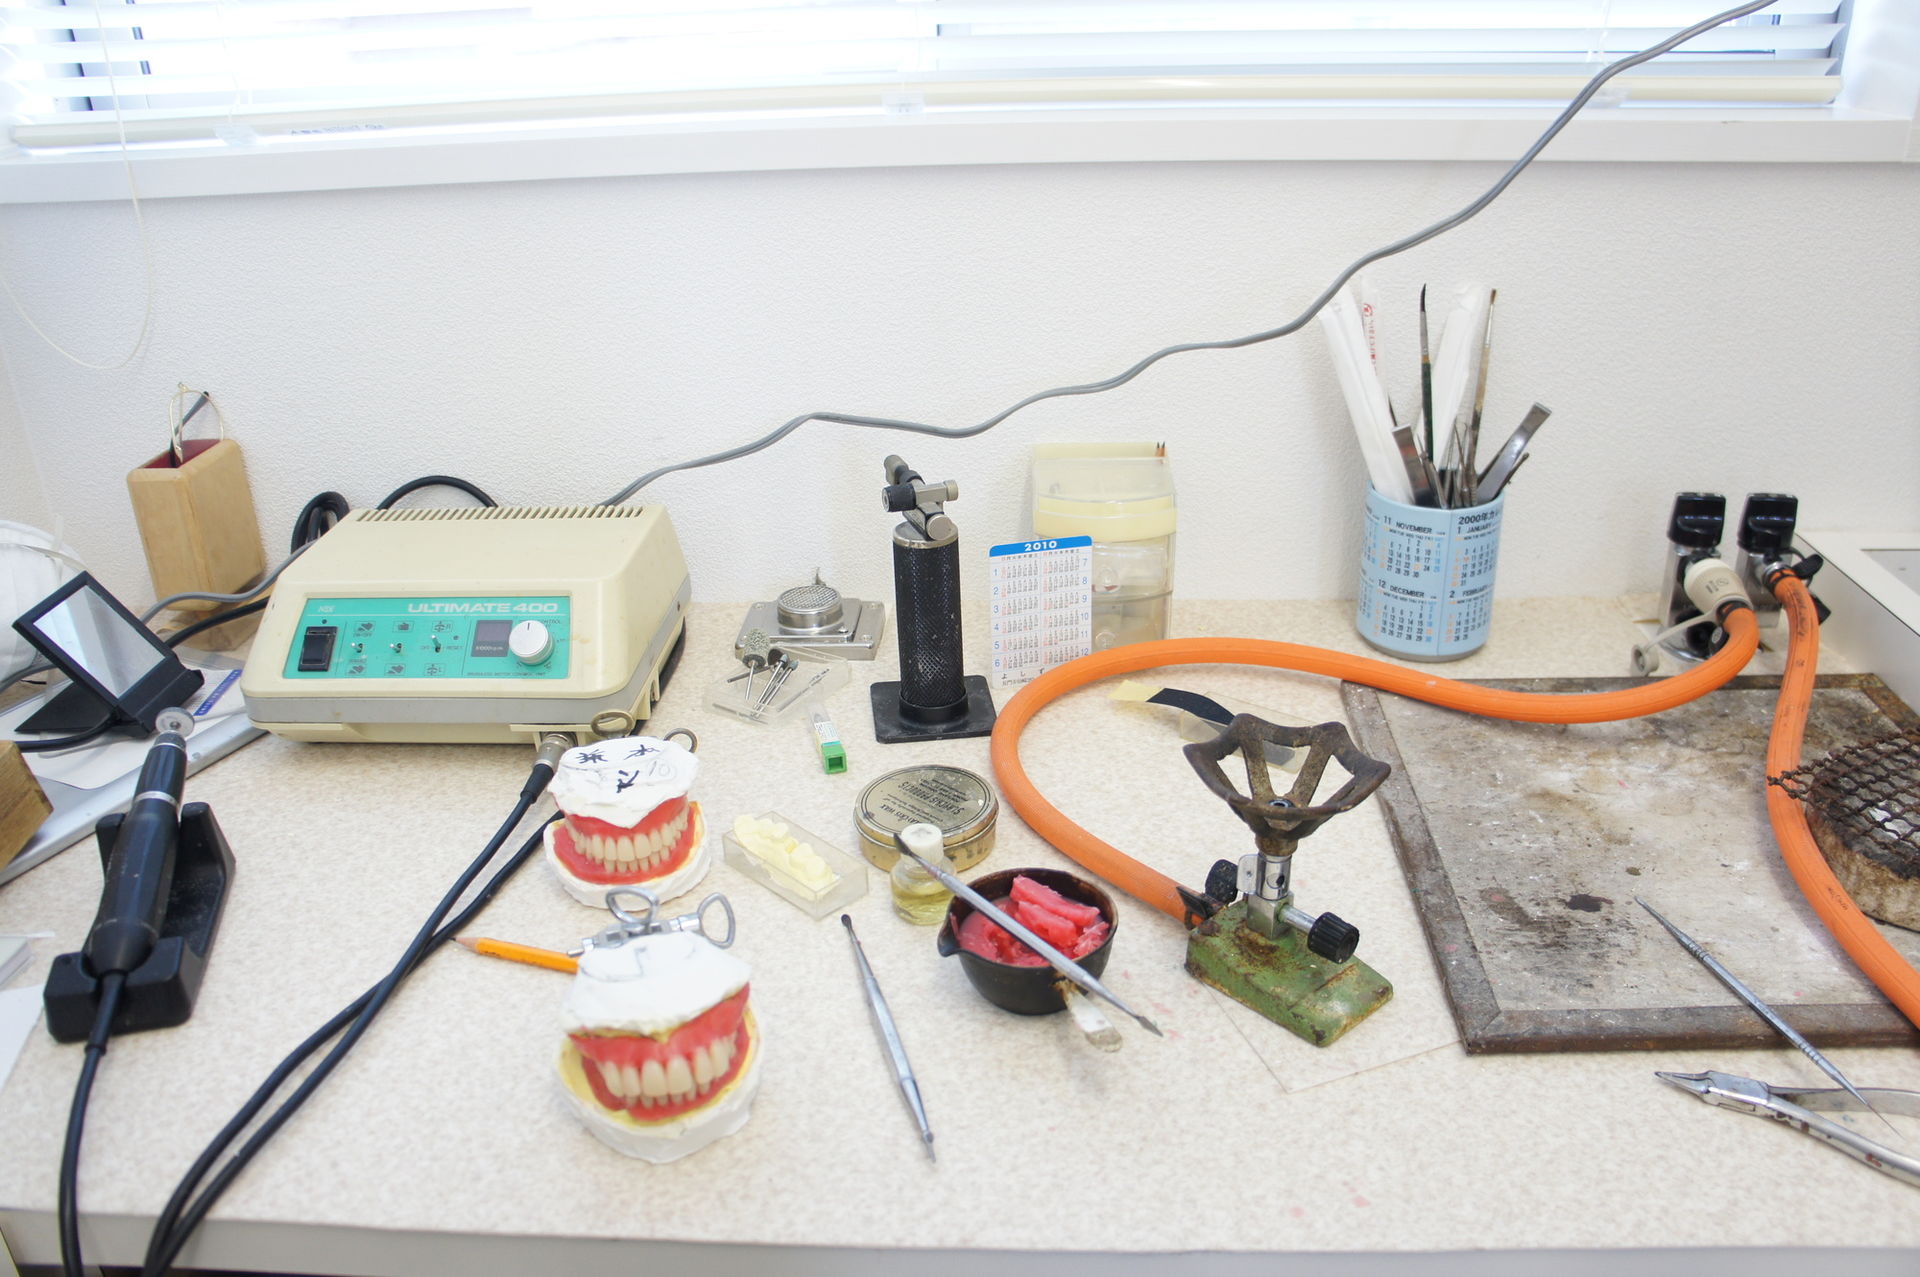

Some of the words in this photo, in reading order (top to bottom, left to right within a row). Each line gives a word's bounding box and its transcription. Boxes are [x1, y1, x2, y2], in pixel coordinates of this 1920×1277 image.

[1383, 515, 1392, 525] 11
[1395, 521, 1432, 534] NOVEMBER
[1024, 540, 1058, 552] 2010
[1082, 558, 1088, 566] 7
[994, 568, 998, 576] 1
[994, 586, 999, 596] 2
[1378, 579, 1386, 588] 12
[1390, 585, 1424, 598] DECEMBER
[1082, 594, 1088, 603] 9
[1449, 590, 1456, 598] 2
[407, 602, 511, 613] ULTIMATE
[513, 602, 559, 613] 400
[994, 605, 999, 614] 3
[1080, 612, 1088, 620] 10
[1080, 630, 1088, 638] 11
[994, 641, 1000, 650] 5
[1080, 648, 1088, 656] 12
[994, 658, 1000, 668] 6
